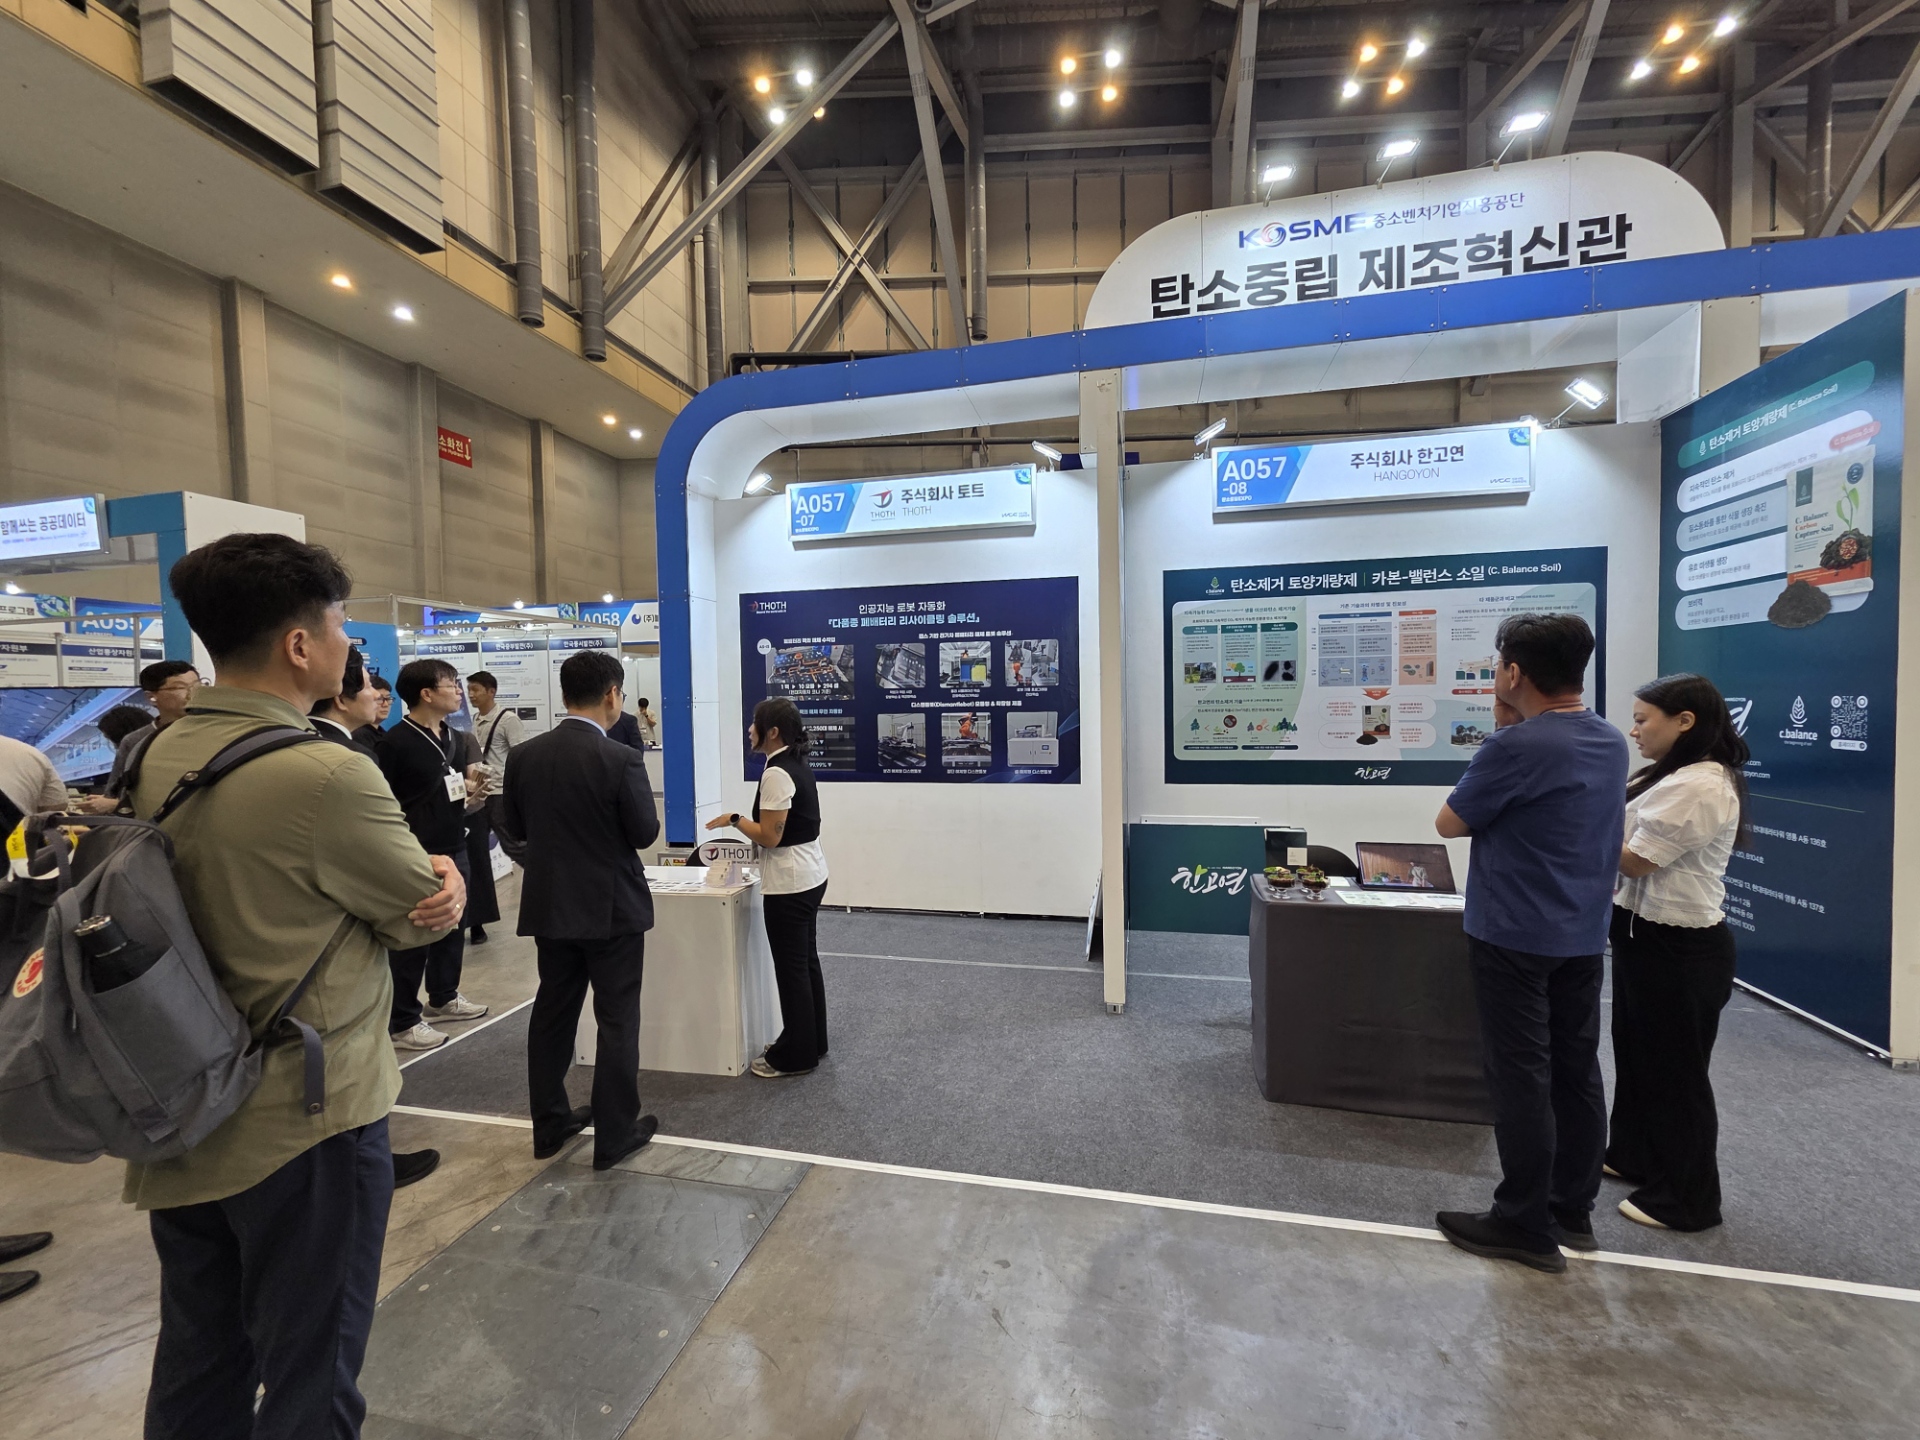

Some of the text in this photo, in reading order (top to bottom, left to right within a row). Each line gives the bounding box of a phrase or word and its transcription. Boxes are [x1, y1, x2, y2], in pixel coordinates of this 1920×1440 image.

[1239, 212, 1366, 248] KOSME
[1151, 212, 1633, 319] 탄소중립 제조혁신관
[1709, 425, 1741, 450] 탄소제거
[1742, 404, 1788, 436] 토양개량제
[438, 435, 463, 453] 소화전
[1350, 445, 1465, 469] 주식회사 한고연
[1222, 456, 1287, 482] A057
[1374, 467, 1440, 482] HANGOYON
[901, 483, 985, 504] 주식회사 토트
[1222, 481, 1248, 495] -08
[795, 492, 845, 515] A057
[902, 506, 932, 517] THOTH
[39, 512, 86, 531] 공공데이터
[795, 515, 815, 527] -07
[1230, 562, 1562, 593] 탄소제거 토양개량제 카본-밸런스 소일 (C. Balance Soil)
[759, 601, 787, 611] THOTH
[858, 601, 946, 615] 인공지능 로봇 자동화
[584, 612, 620, 627] A058
[899, 613, 945, 626] 리사이클링
[88, 647, 135, 657] 산업통상자원
[1779, 729, 1818, 741] c.balance
